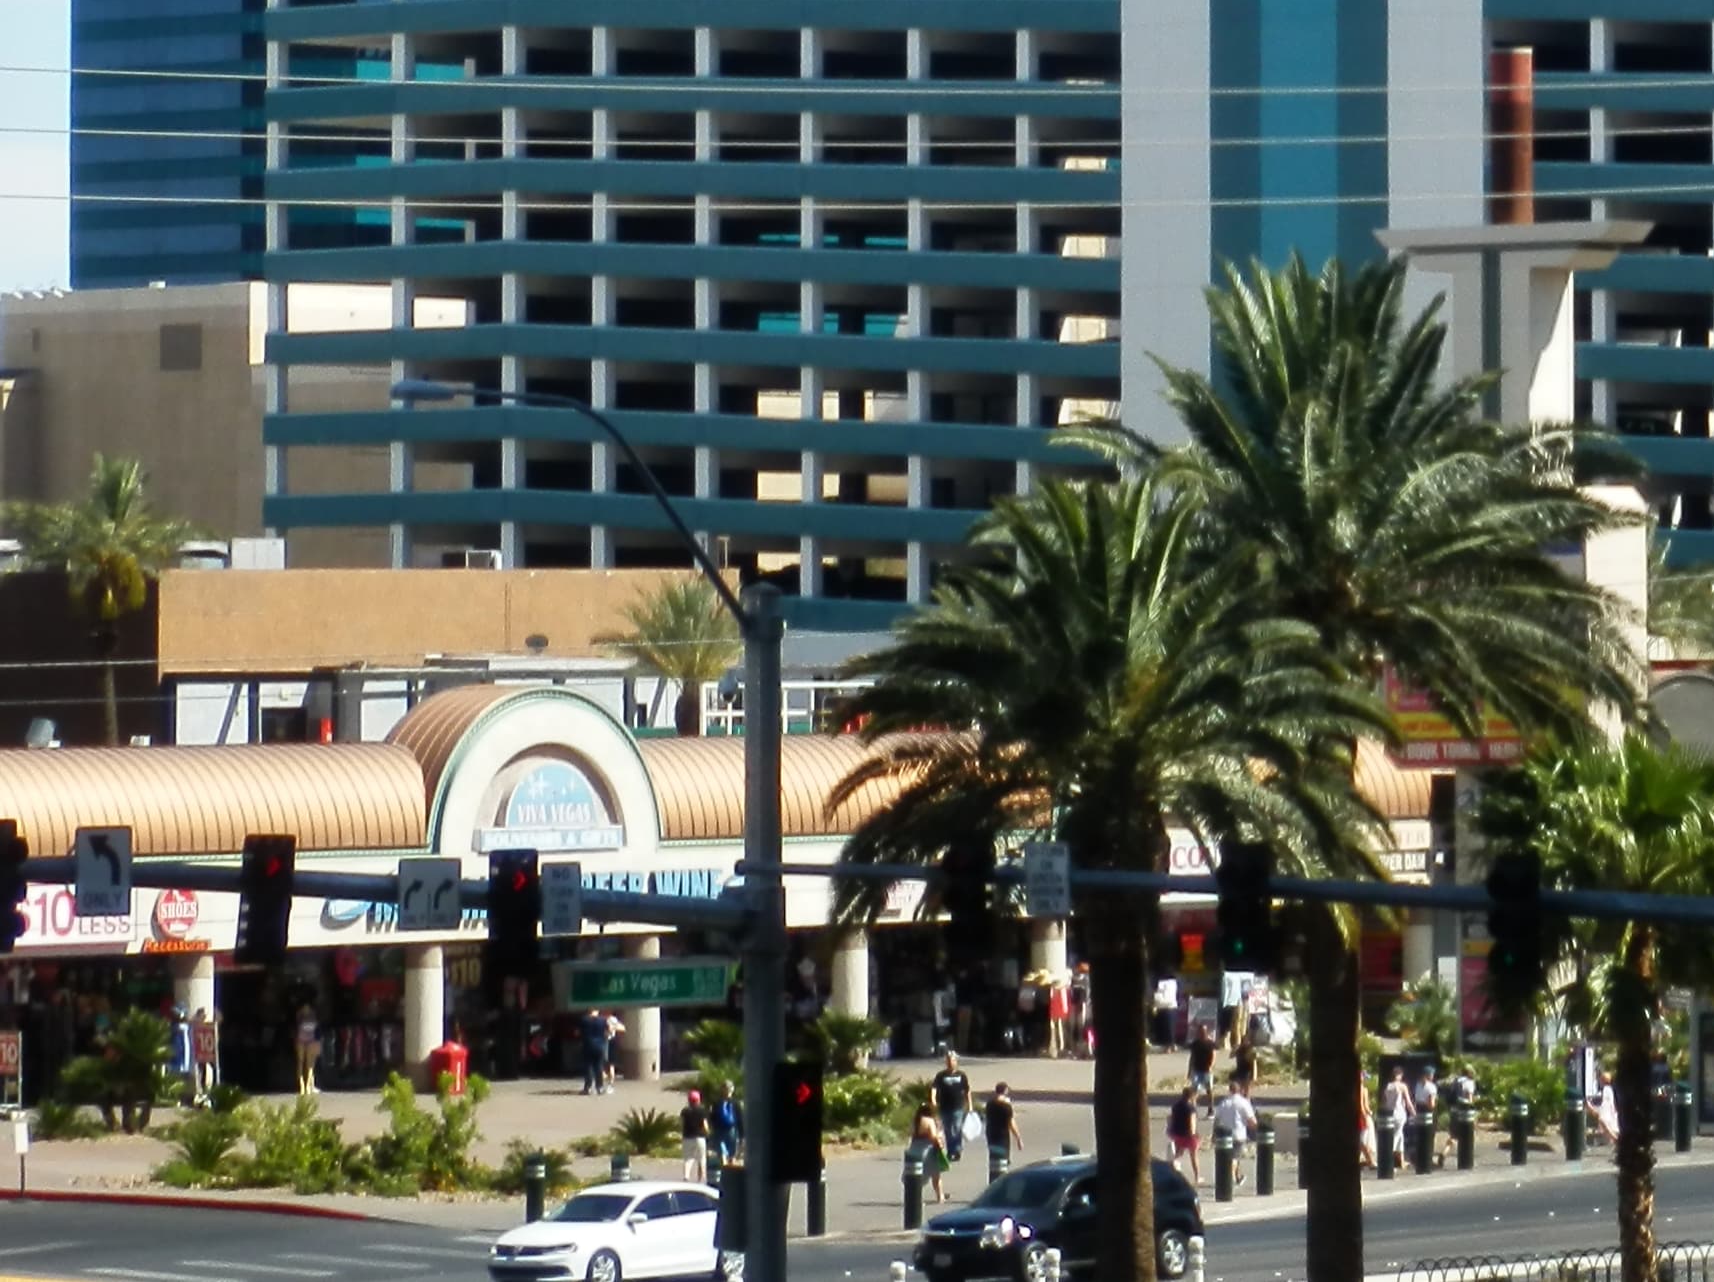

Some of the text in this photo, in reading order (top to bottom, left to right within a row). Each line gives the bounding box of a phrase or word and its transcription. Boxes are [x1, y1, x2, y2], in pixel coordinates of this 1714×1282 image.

[517, 802, 591, 824] VIVA VEGAS
[160, 901, 198, 919] SHOES
[630, 973, 677, 999] Vegas
